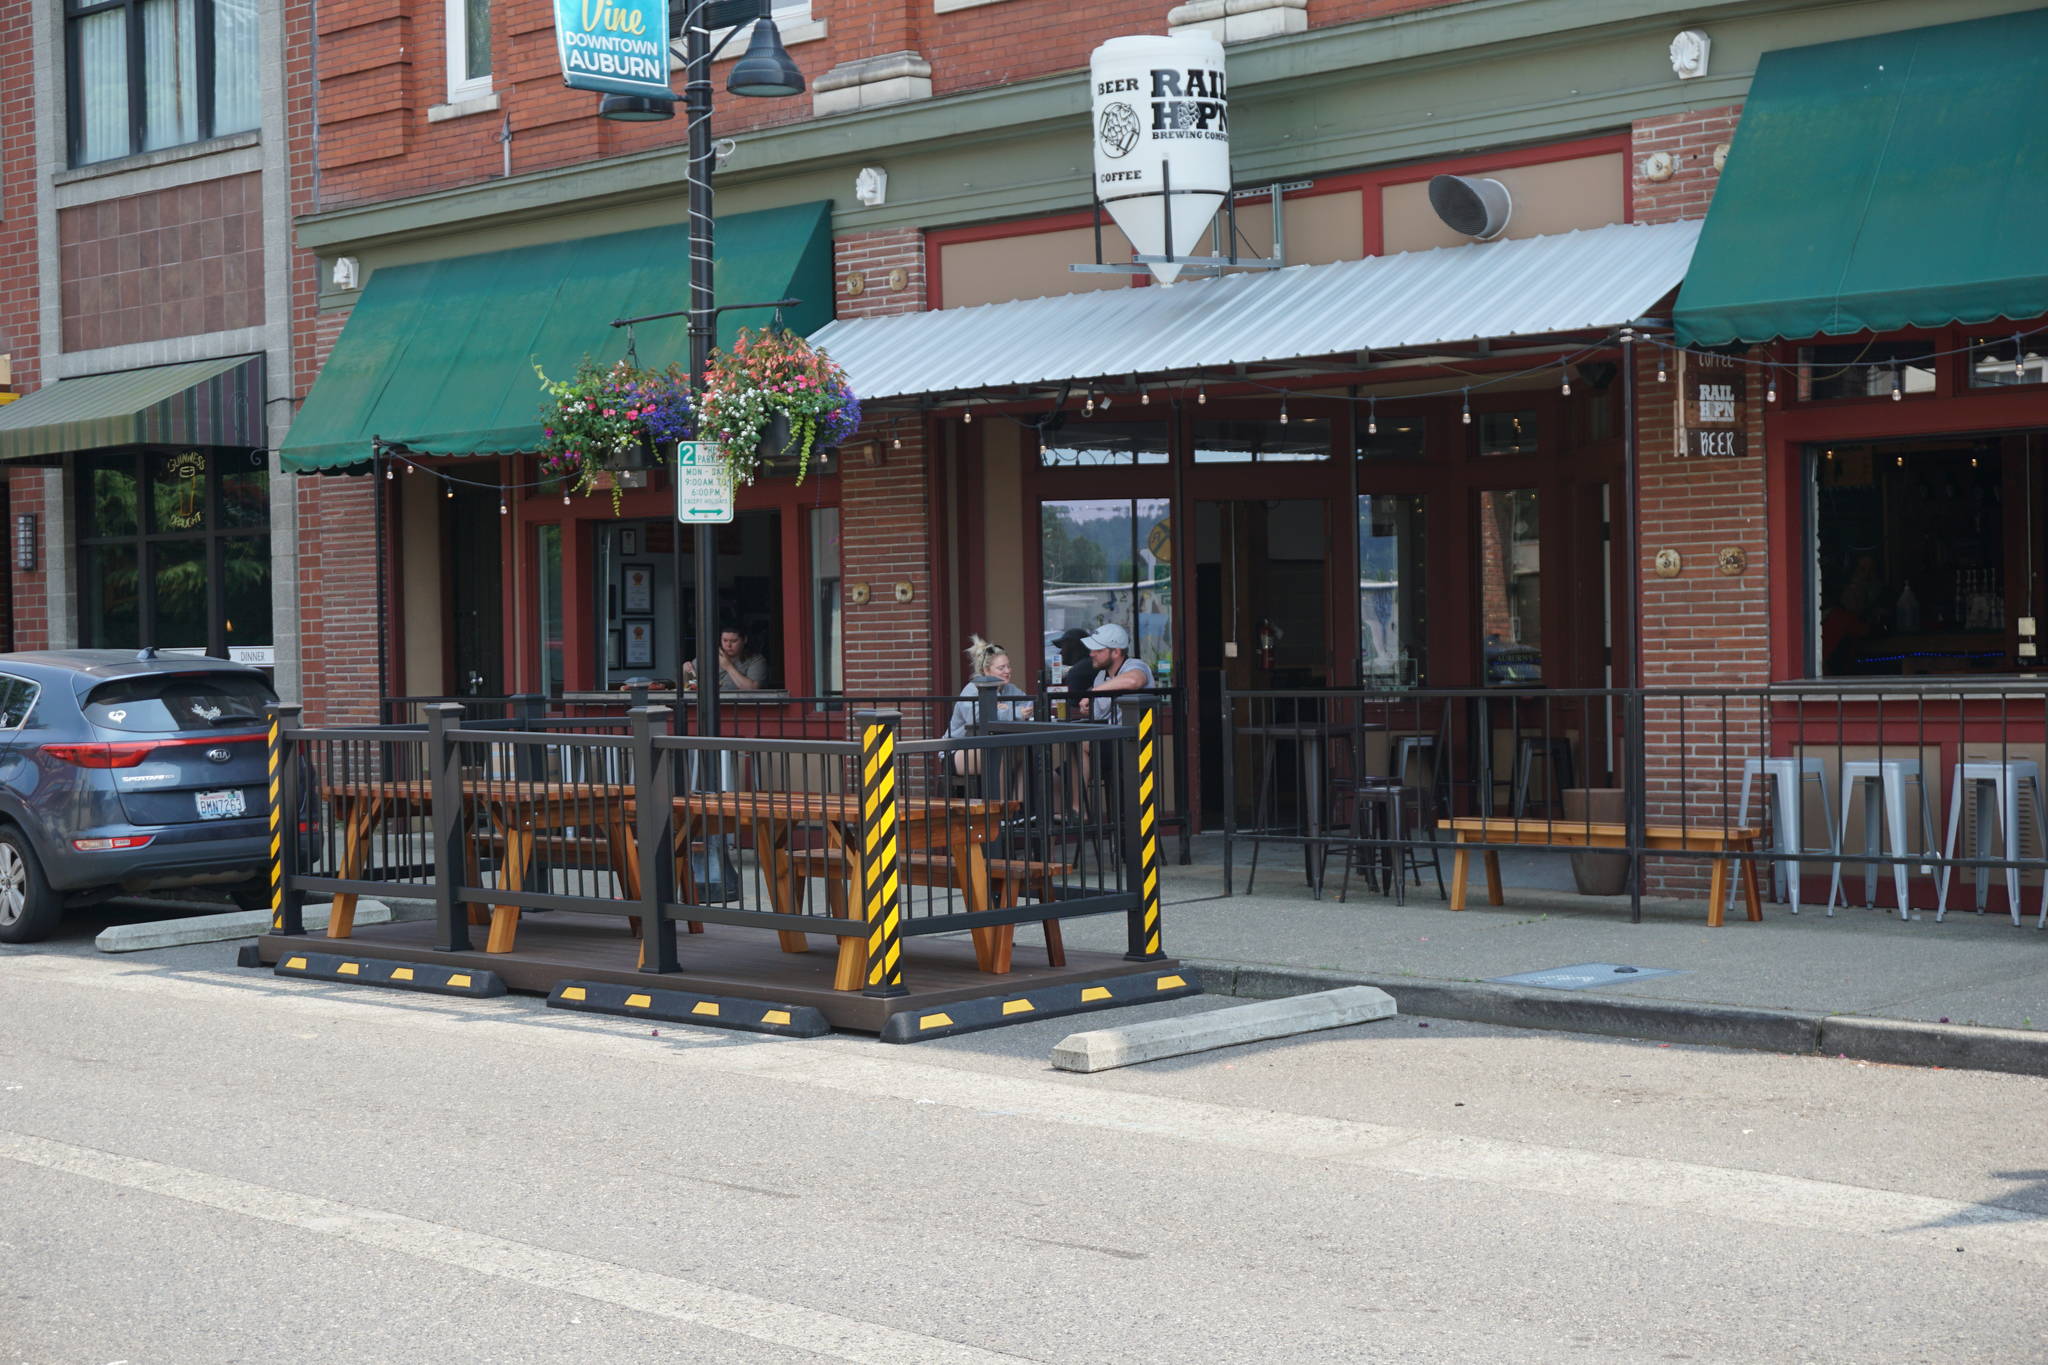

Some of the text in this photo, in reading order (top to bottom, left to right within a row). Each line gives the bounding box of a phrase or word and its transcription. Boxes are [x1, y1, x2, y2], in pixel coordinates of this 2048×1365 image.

[582, 0, 646, 35] Vine
[565, 31, 658, 56] DOWNTOWN
[569, 49, 660, 79] AUBURN
[1098, 78, 1139, 96] BEER
[1152, 131, 1203, 140] BREWING
[1101, 169, 1142, 183] COFFEE
[1699, 384, 1735, 401] RAIL
[1700, 431, 1735, 456] BEER
[682, 445, 694, 464] 2
[685, 478, 713, 486] 9:00AM
[691, 488, 720, 496] 6:00PM
[240, 651, 265, 662] DINNER
[213, 751, 231, 761] KIA
